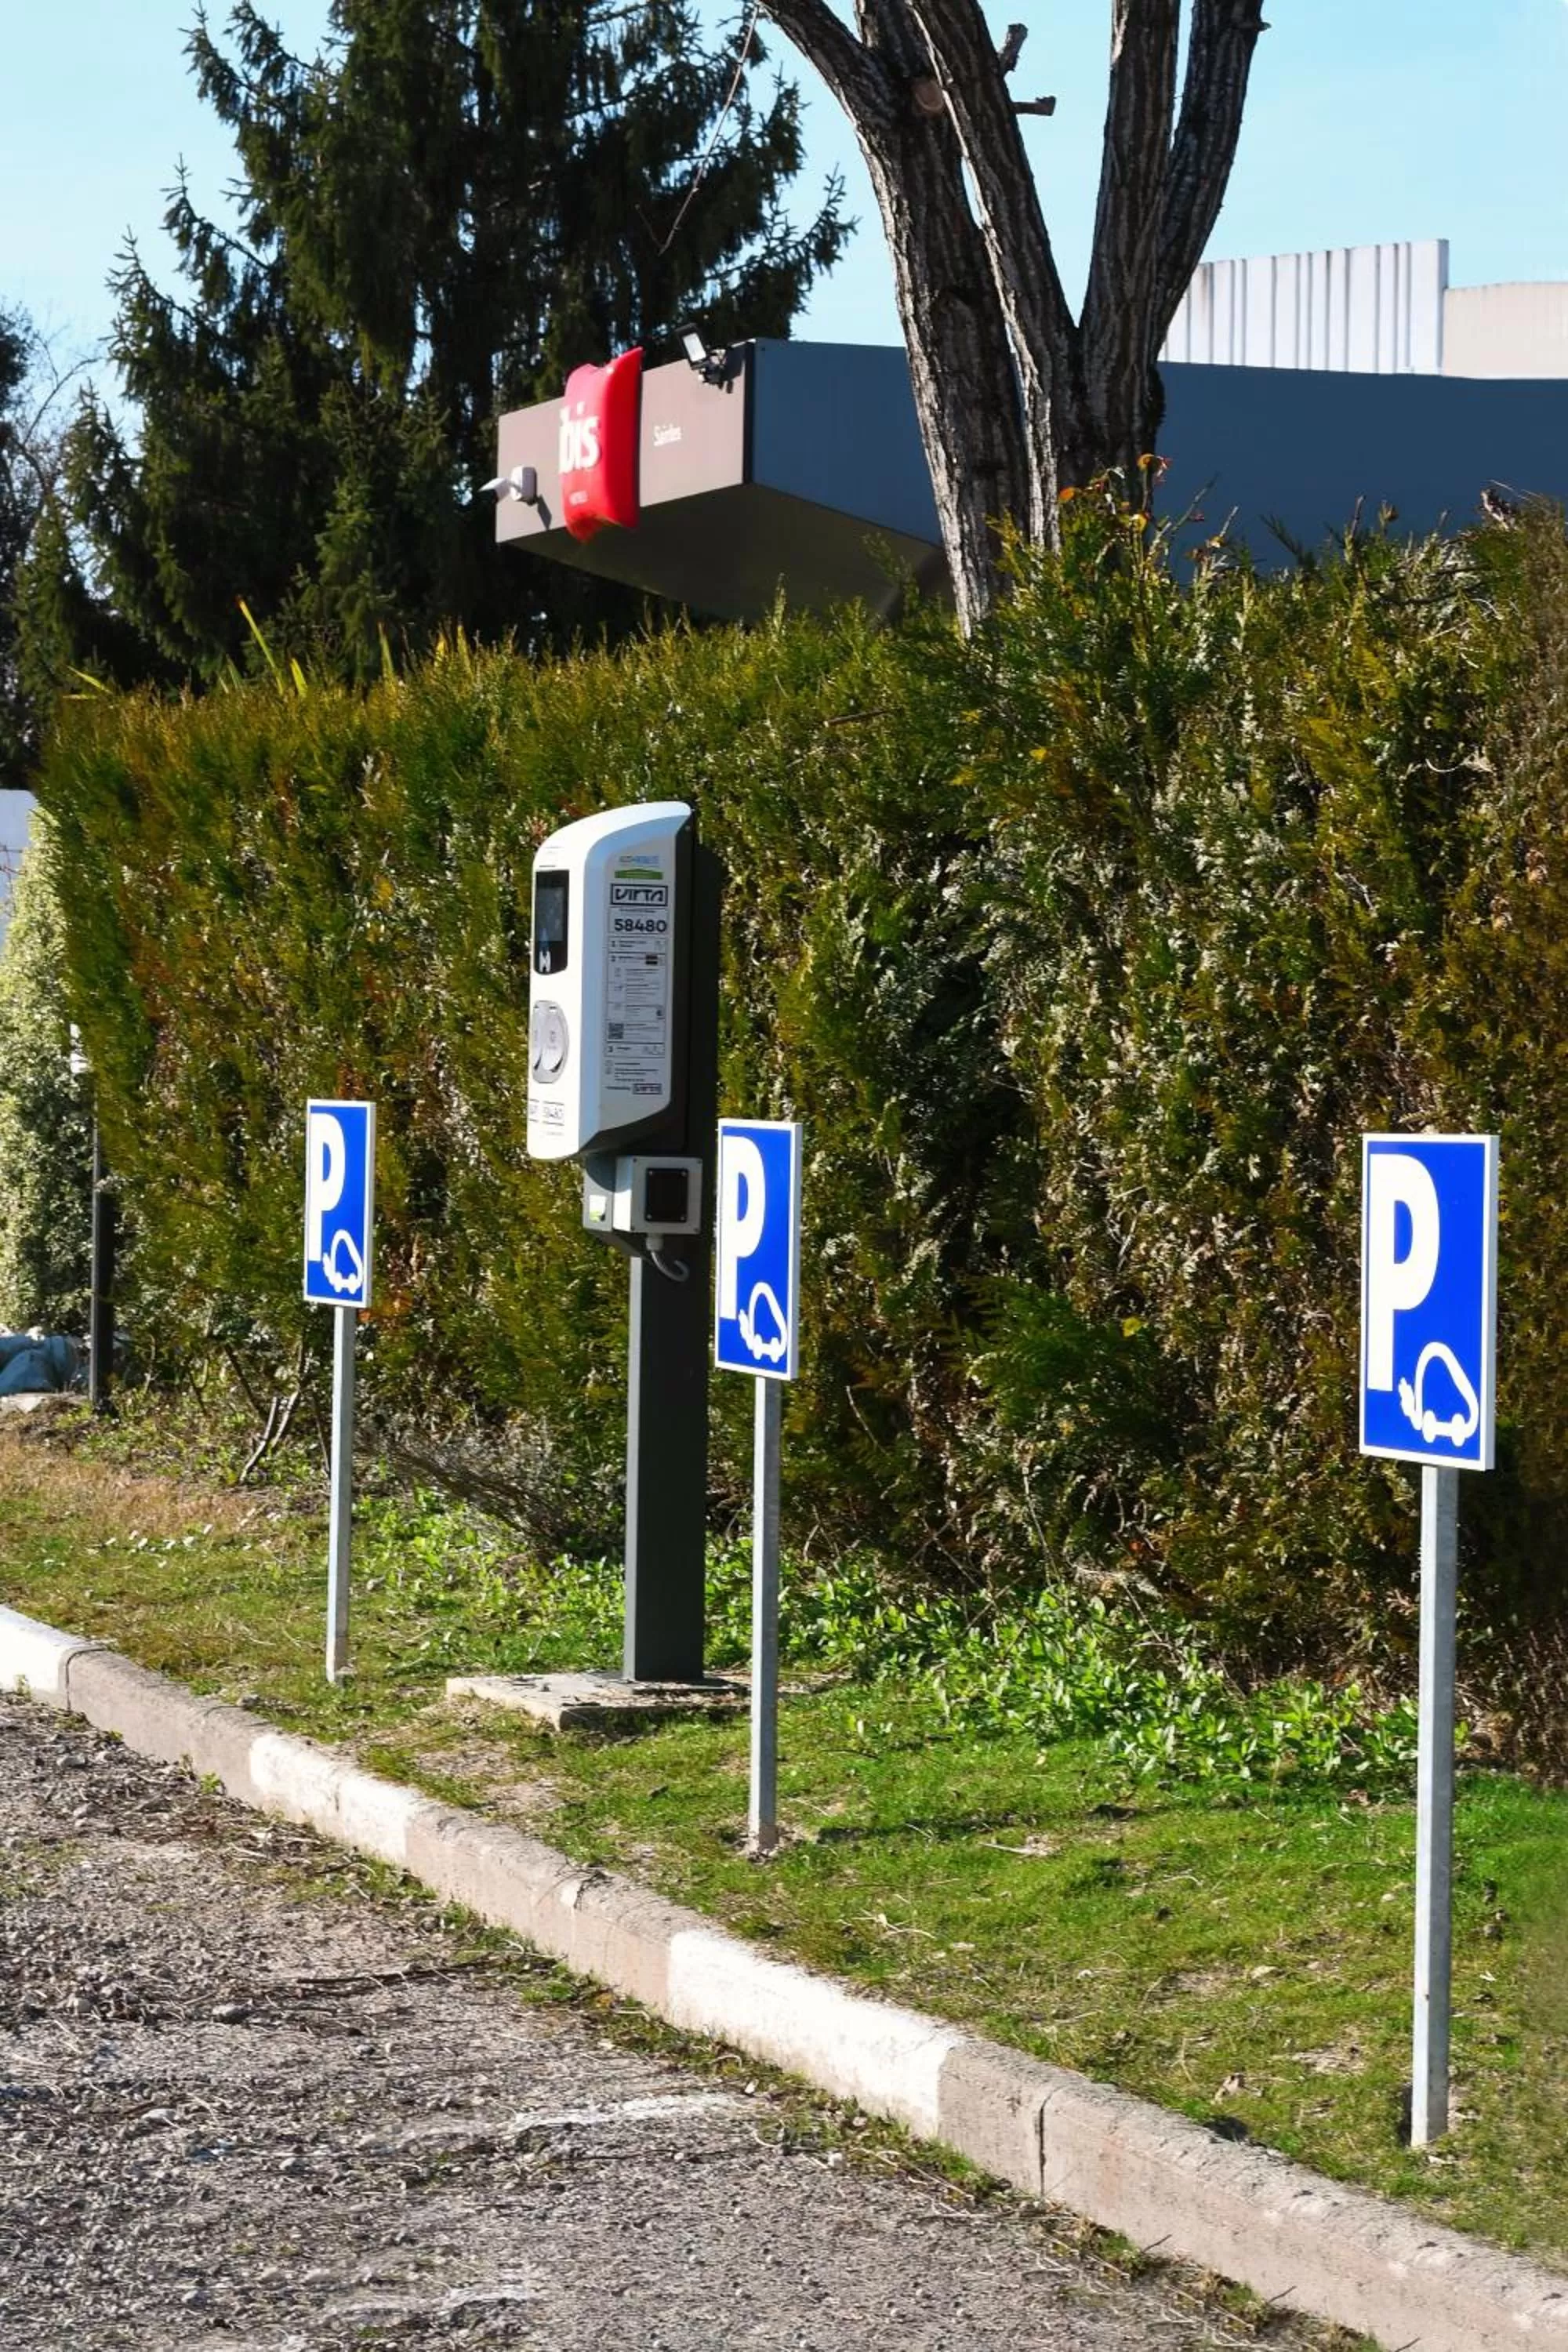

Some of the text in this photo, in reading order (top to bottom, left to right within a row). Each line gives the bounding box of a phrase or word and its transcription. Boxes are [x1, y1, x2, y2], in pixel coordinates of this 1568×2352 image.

[614, 918, 667, 933] 58480
[308, 1112, 345, 1261] P
[720, 1135, 766, 1320] P
[1367, 1153, 1440, 1392] P
